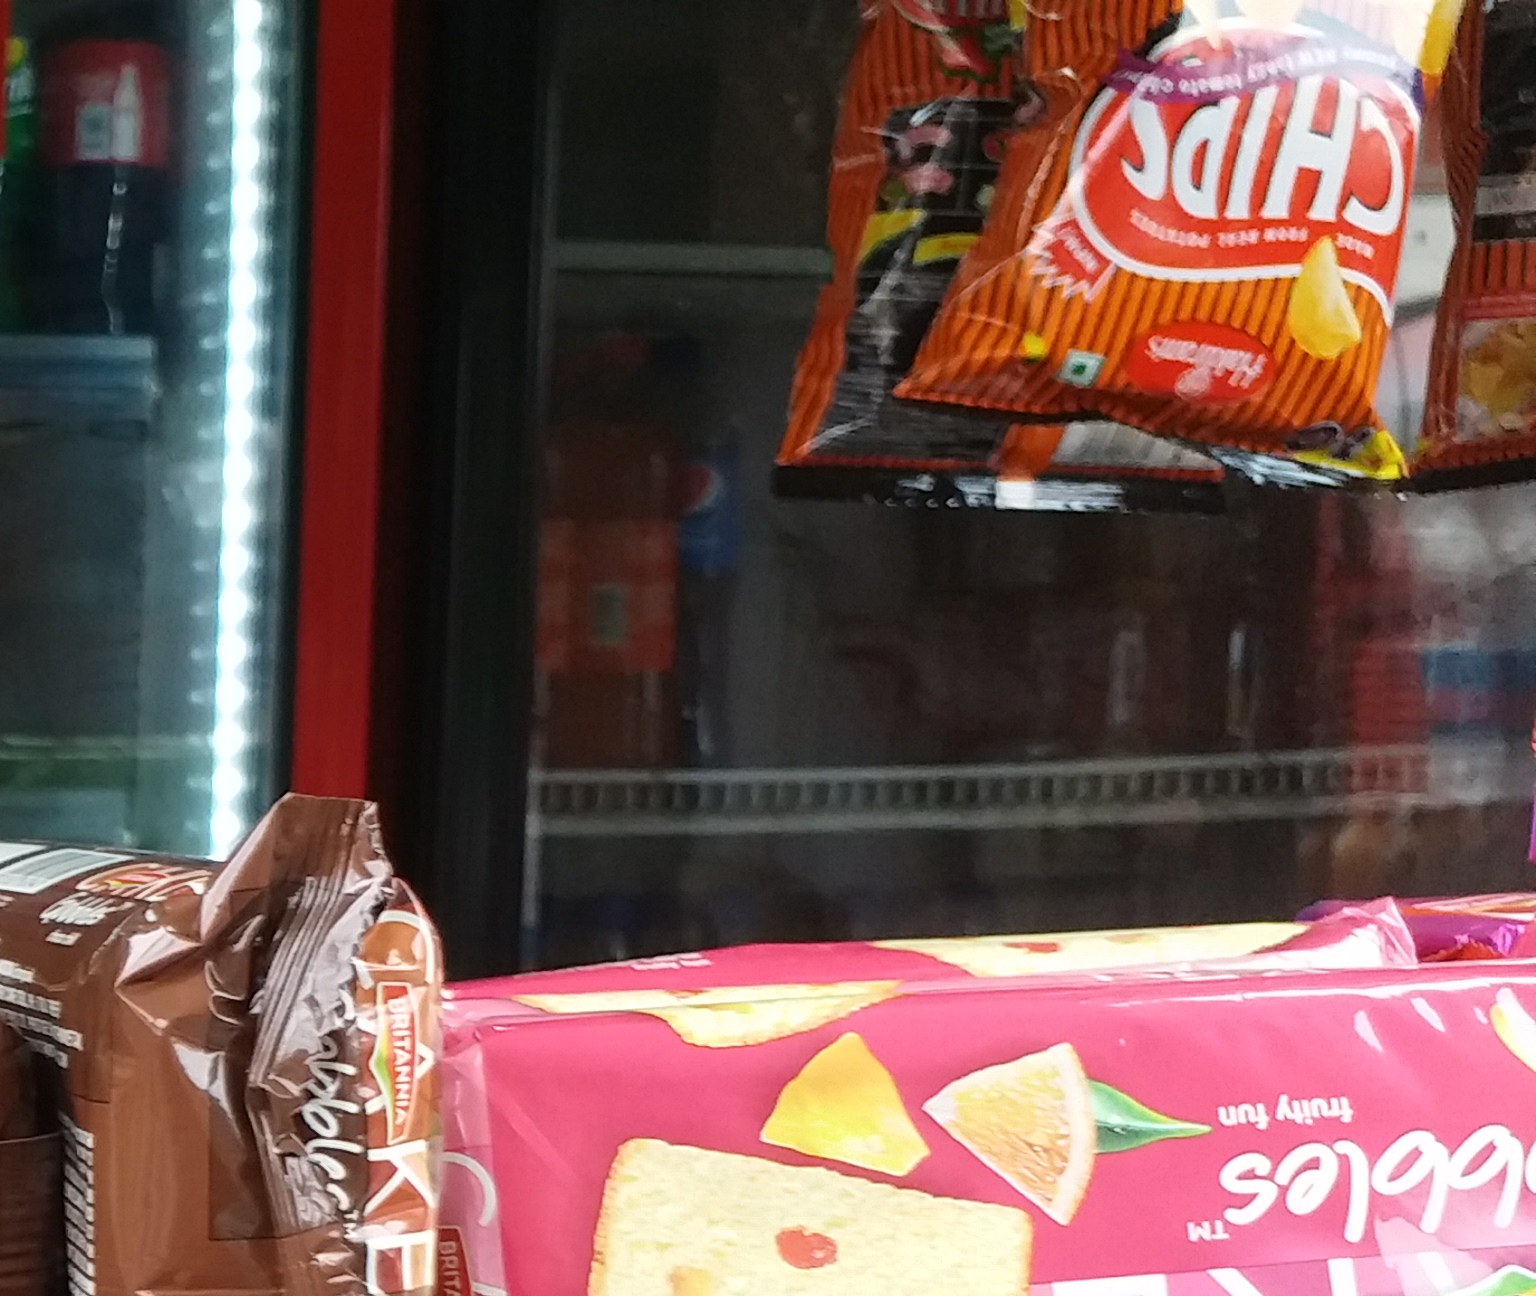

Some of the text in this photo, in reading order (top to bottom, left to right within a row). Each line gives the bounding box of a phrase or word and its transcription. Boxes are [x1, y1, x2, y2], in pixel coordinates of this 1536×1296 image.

[1121, 76, 1405, 236] CHIPS
[388, 997, 413, 1127] BRITANNIA
[1218, 1095, 1353, 1130] fruity fun
